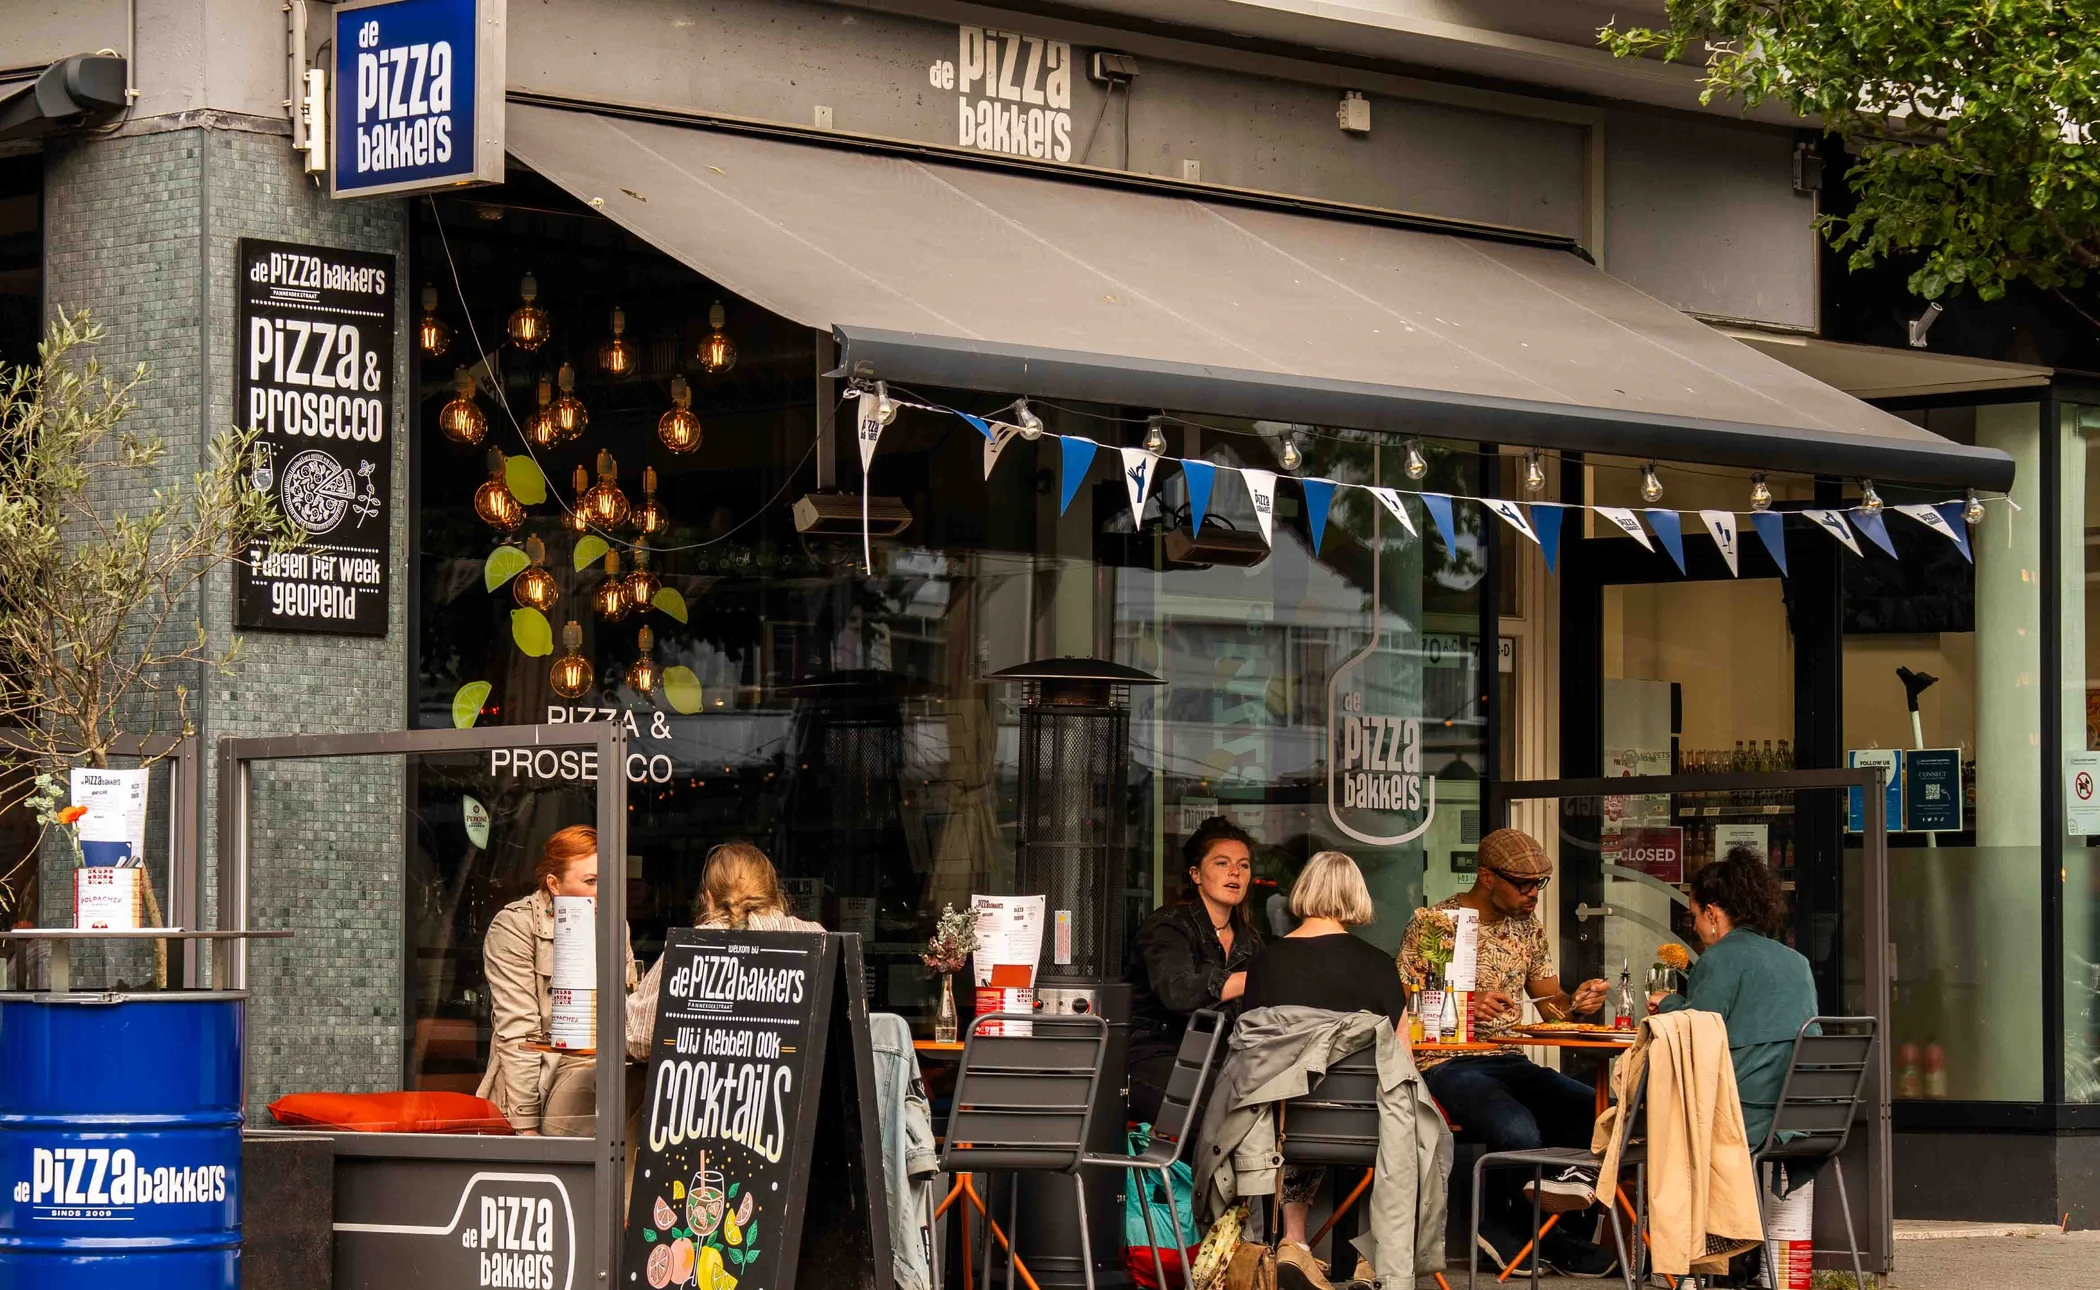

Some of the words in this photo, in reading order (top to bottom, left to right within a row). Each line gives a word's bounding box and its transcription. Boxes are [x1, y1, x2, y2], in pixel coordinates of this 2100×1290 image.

[358, 20, 379, 48] de
[929, 59, 954, 90] de
[357, 115, 452, 173] bakkers
[959, 96, 1072, 162] bakkers
[250, 262, 268, 283] de
[323, 263, 386, 295] bakkers
[363, 351, 381, 391] &
[250, 387, 383, 443] prosecco
[263, 551, 308, 579] dagen
[312, 555, 337, 581] per
[339, 557, 380, 584] week
[272, 581, 356, 620] geopend
[1344, 691, 1361, 712] de
[650, 711, 672, 739] &
[491, 749, 673, 783] PROSECO
[1344, 772, 1421, 811] bakkers
[1620, 848, 1676, 862] CLOSED
[669, 966, 690, 998] de
[737, 966, 805, 1004] bakkers
[703, 1028, 753, 1056] hebben
[14, 1181, 30, 1203] de
[136, 1164, 226, 1205] bakkers
[462, 1228, 478, 1248] de
[480, 1252, 554, 1290] bakkers
